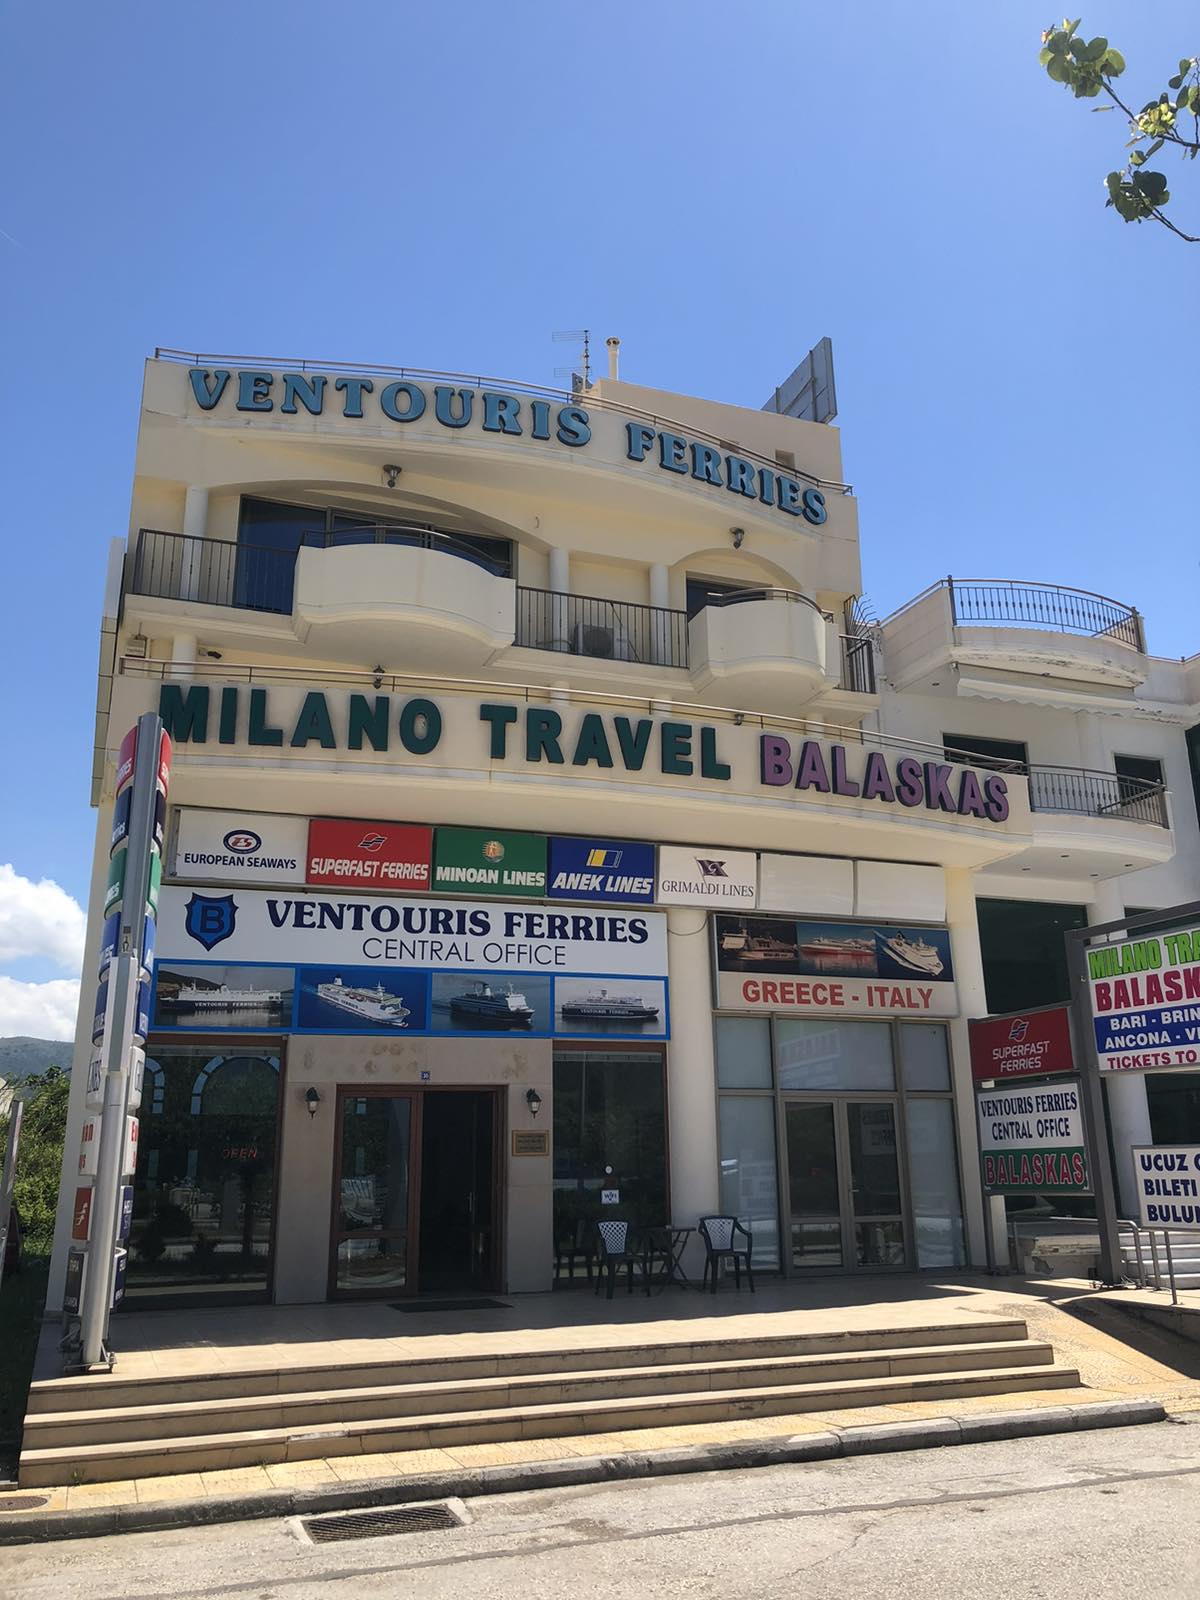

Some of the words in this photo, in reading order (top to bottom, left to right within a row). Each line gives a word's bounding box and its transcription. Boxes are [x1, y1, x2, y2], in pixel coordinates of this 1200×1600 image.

[188, 368, 592, 447] VENTOURIS
[624, 422, 829, 525] FERRIES
[159, 684, 443, 755] MILANO
[480, 703, 732, 780] TRAVEL
[760, 734, 1009, 822] BALASKAS
[184, 852, 244, 868] EUROPEAN
[246, 856, 297, 870] SEAWAYS
[310, 857, 380, 878] SUPERFAST
[380, 862, 429, 881] FERRIES
[436, 866, 499, 885] MINOAN
[502, 870, 546, 888] LINES
[552, 872, 605, 891] ANEK
[598, 875, 654, 895] LINES
[661, 879, 721, 895] GRIMALDI
[721, 884, 755, 898] LINES
[266, 899, 491, 937] VENTOURIS
[503, 911, 649, 944] FERRIES
[362, 937, 475, 963] CENTRAL
[482, 942, 567, 966] OFFICE
[1088, 938, 1162, 980] MILANO
[741, 979, 845, 1006] GREECE
[866, 985, 934, 1009] ITALY
[1110, 1014, 1147, 1031] BARI
[992, 1040, 1051, 1060] SUPERFAST
[1104, 1030, 1172, 1050] ANCONA
[1000, 1056, 1043, 1073] FERRIES
[1106, 1052, 1171, 1070] TICKETS
[1174, 1049, 1198, 1064] TO
[980, 1095, 1034, 1118] VENTOURIS
[1035, 1091, 1078, 1113] FERRIES
[991, 1121, 1033, 1141] CENTRAL
[1036, 1117, 1071, 1138] OFFICE
[984, 1152, 1087, 1185] BALASKAS
[1140, 1153, 1189, 1171] UCUZ
[1143, 1179, 1198, 1196] BILETI
